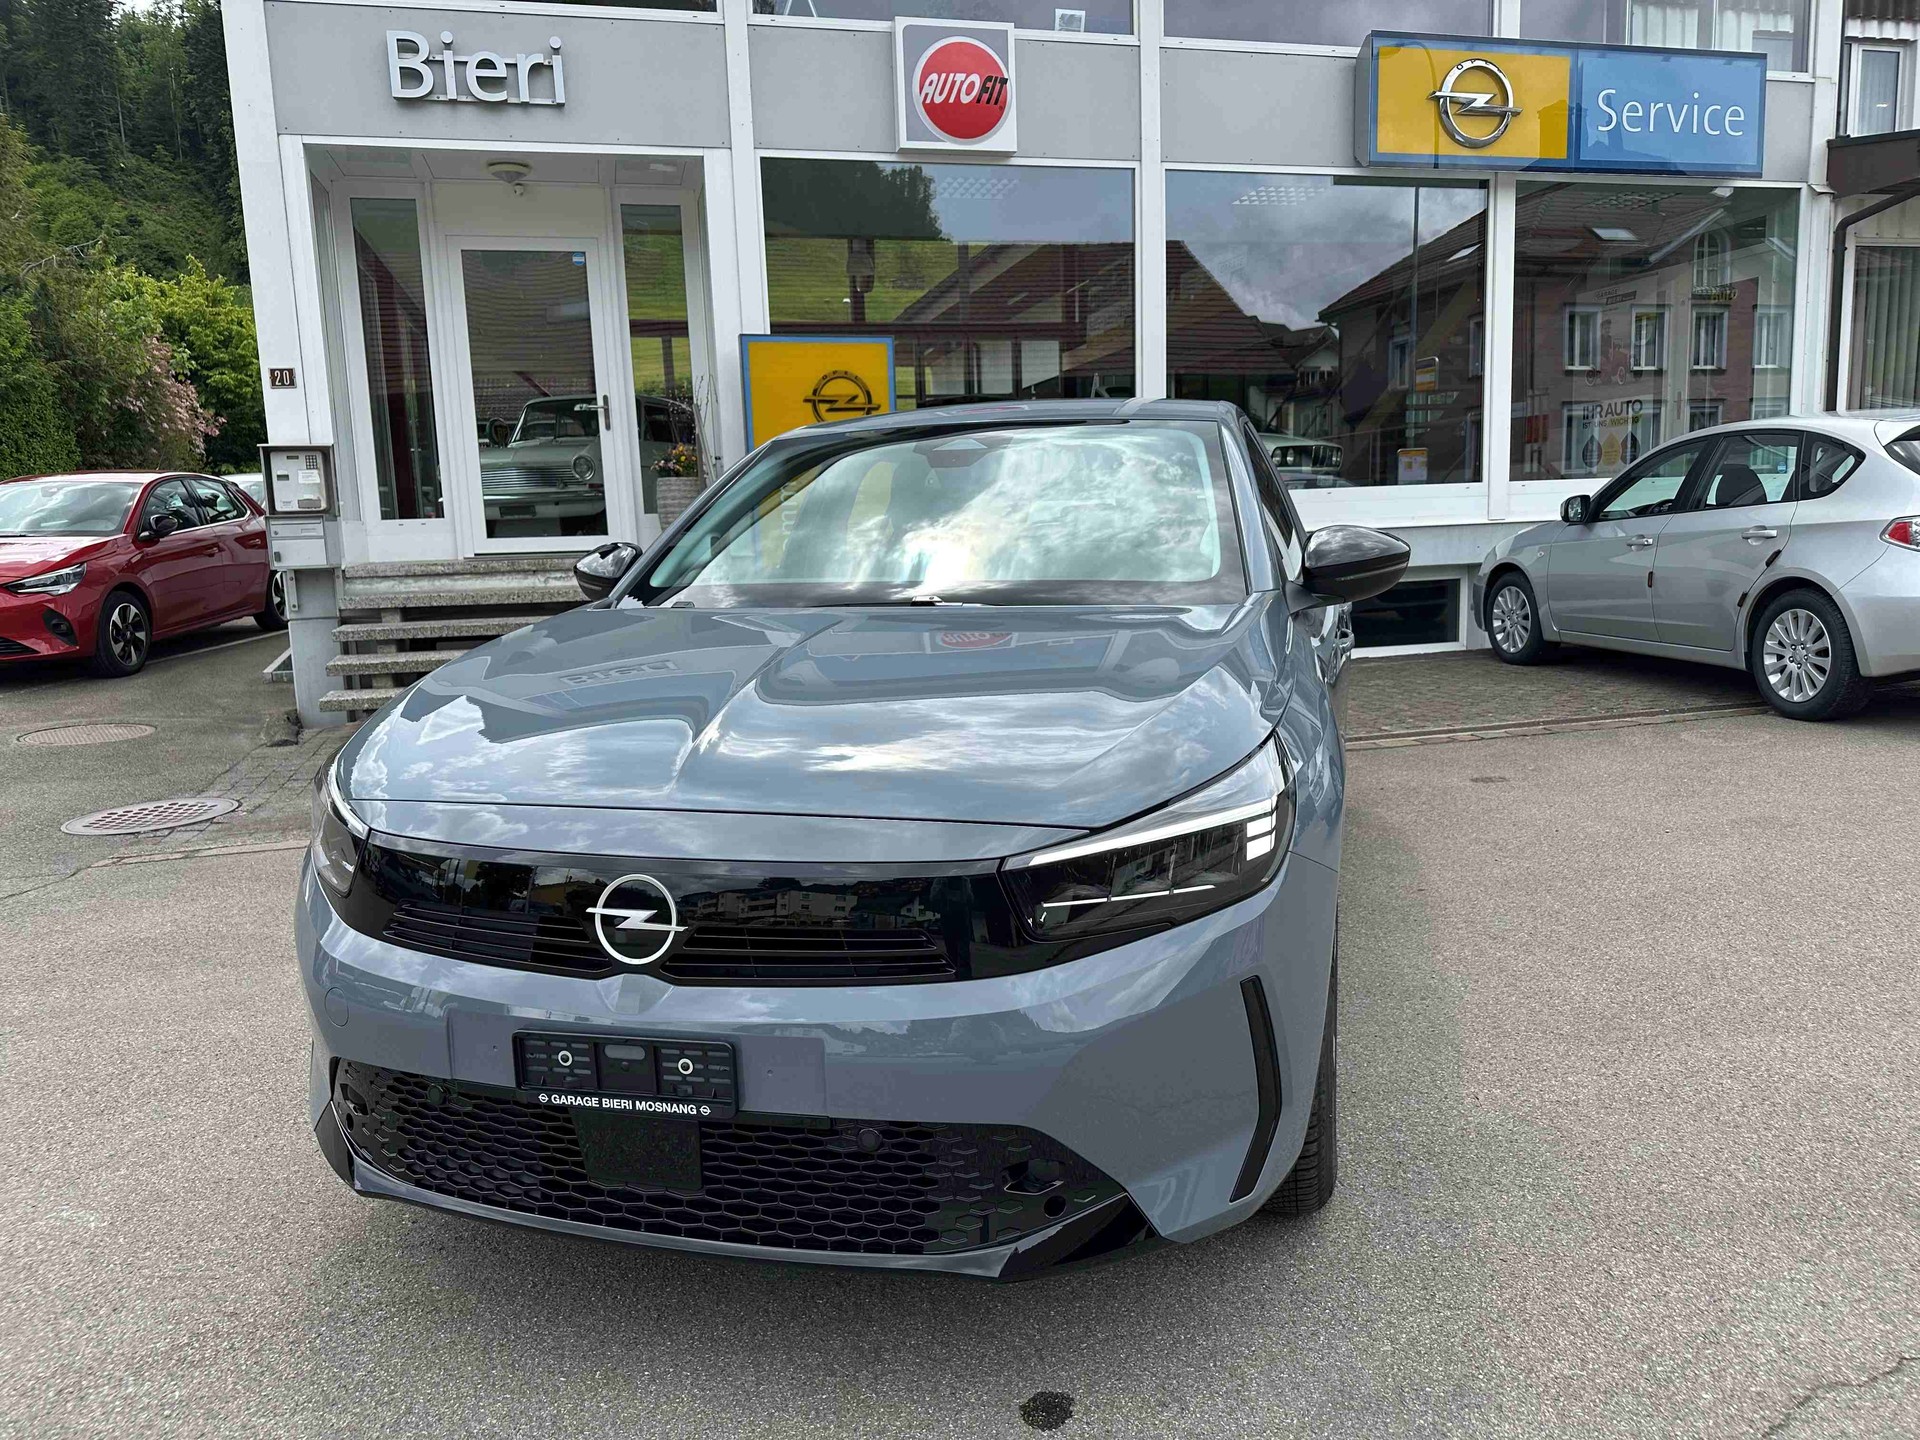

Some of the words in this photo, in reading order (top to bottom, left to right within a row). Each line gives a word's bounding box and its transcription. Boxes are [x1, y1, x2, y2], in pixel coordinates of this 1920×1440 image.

[386, 30, 566, 106] Bieri
[921, 72, 1009, 106] AUTOFIT
[1597, 88, 1745, 137] Service
[275, 370, 290, 385] 20
[1604, 399, 1643, 418] AUTO
[551, 1094, 600, 1108] GARAGE
[602, 1097, 633, 1110] BIERI
[635, 1100, 697, 1115] MOSNANG
